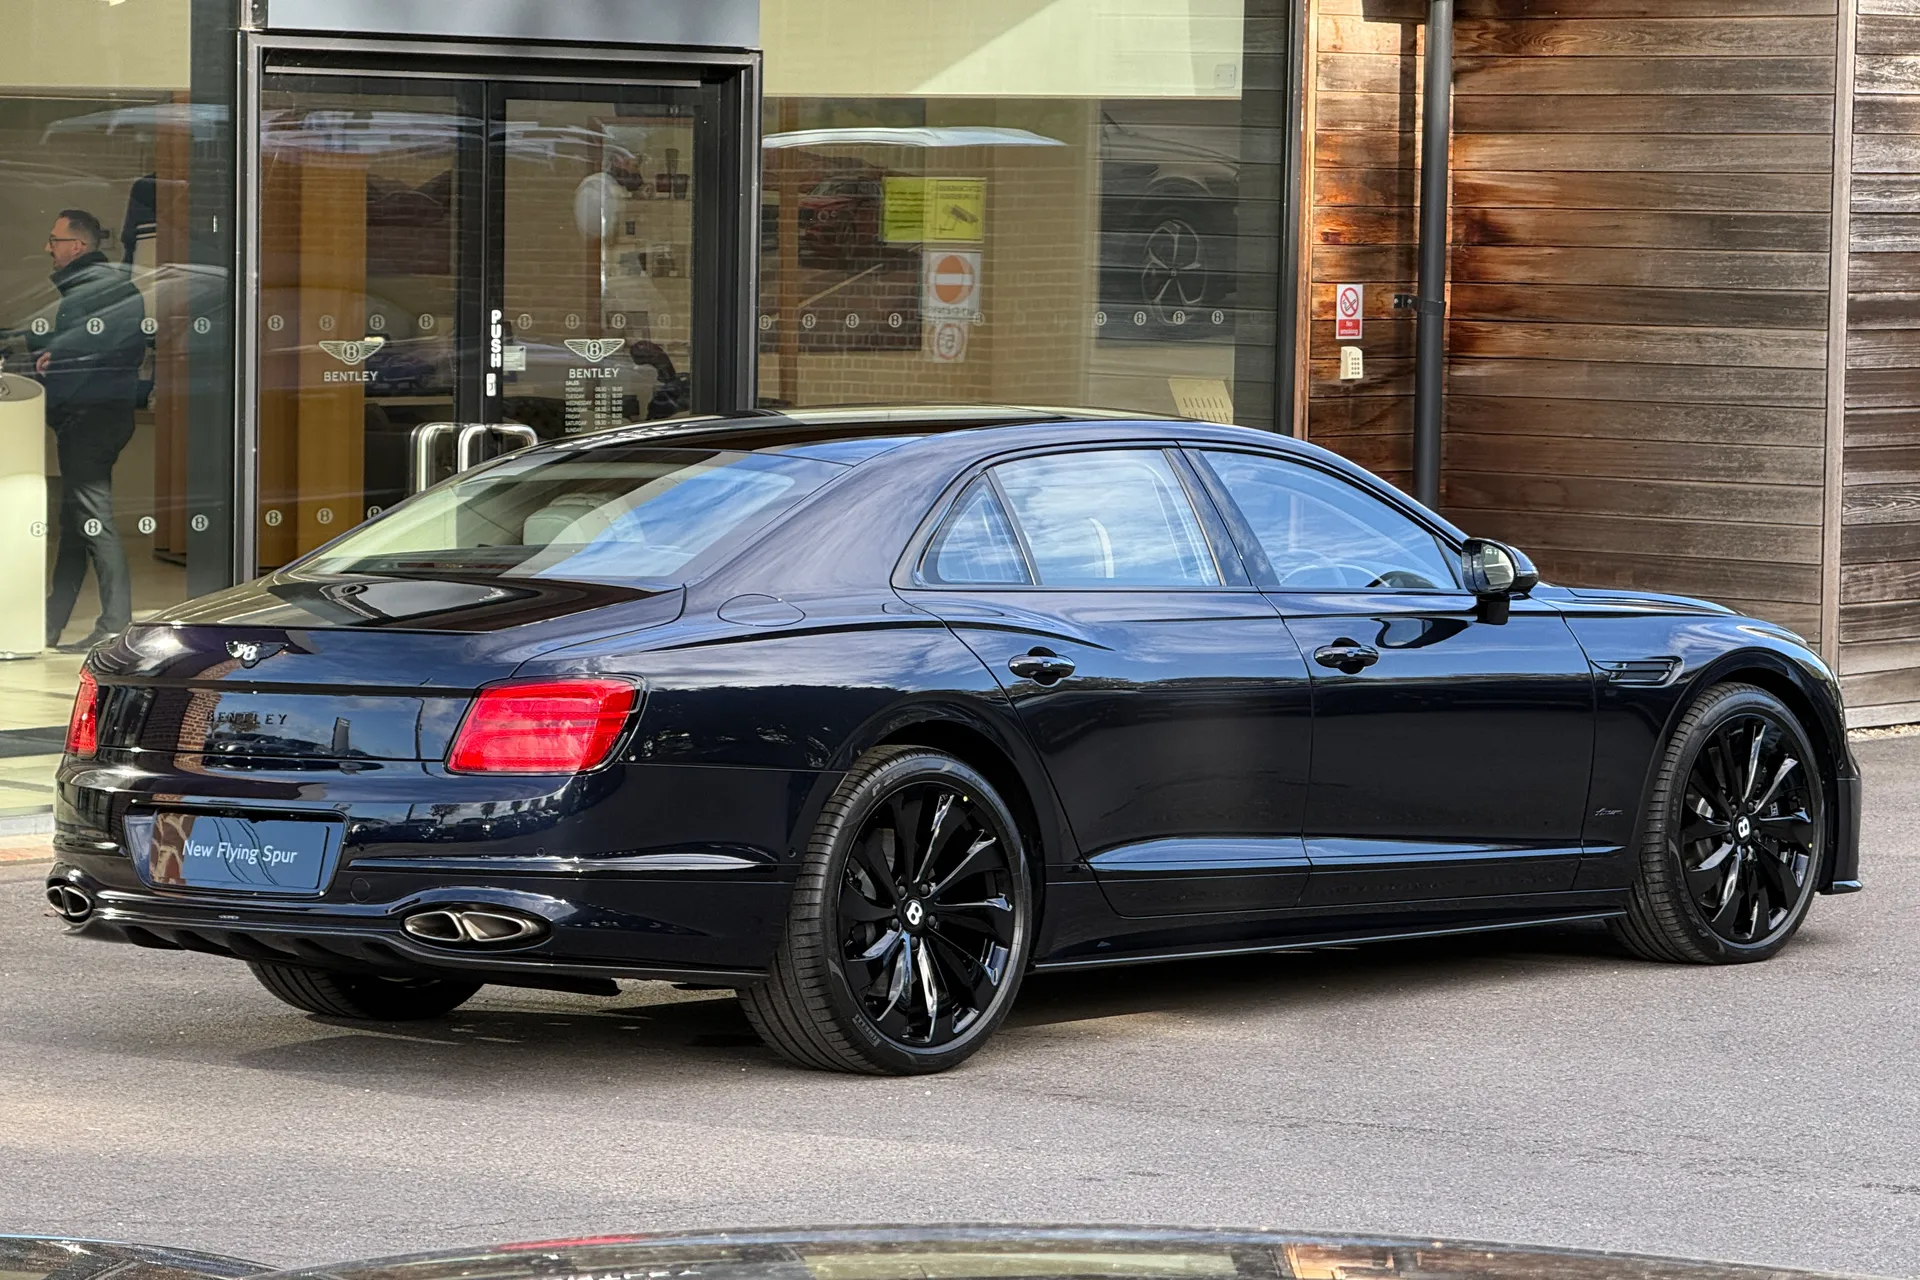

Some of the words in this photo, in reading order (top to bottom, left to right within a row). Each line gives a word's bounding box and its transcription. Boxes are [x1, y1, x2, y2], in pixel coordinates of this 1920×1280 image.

[491, 309, 502, 368] PUSH
[323, 370, 378, 382] BENTLEY
[568, 367, 619, 379] BENTLEY
[207, 710, 287, 725] BENTLEY
[182, 840, 214, 857] New
[217, 841, 259, 865] Flying
[262, 845, 298, 866] Spur
